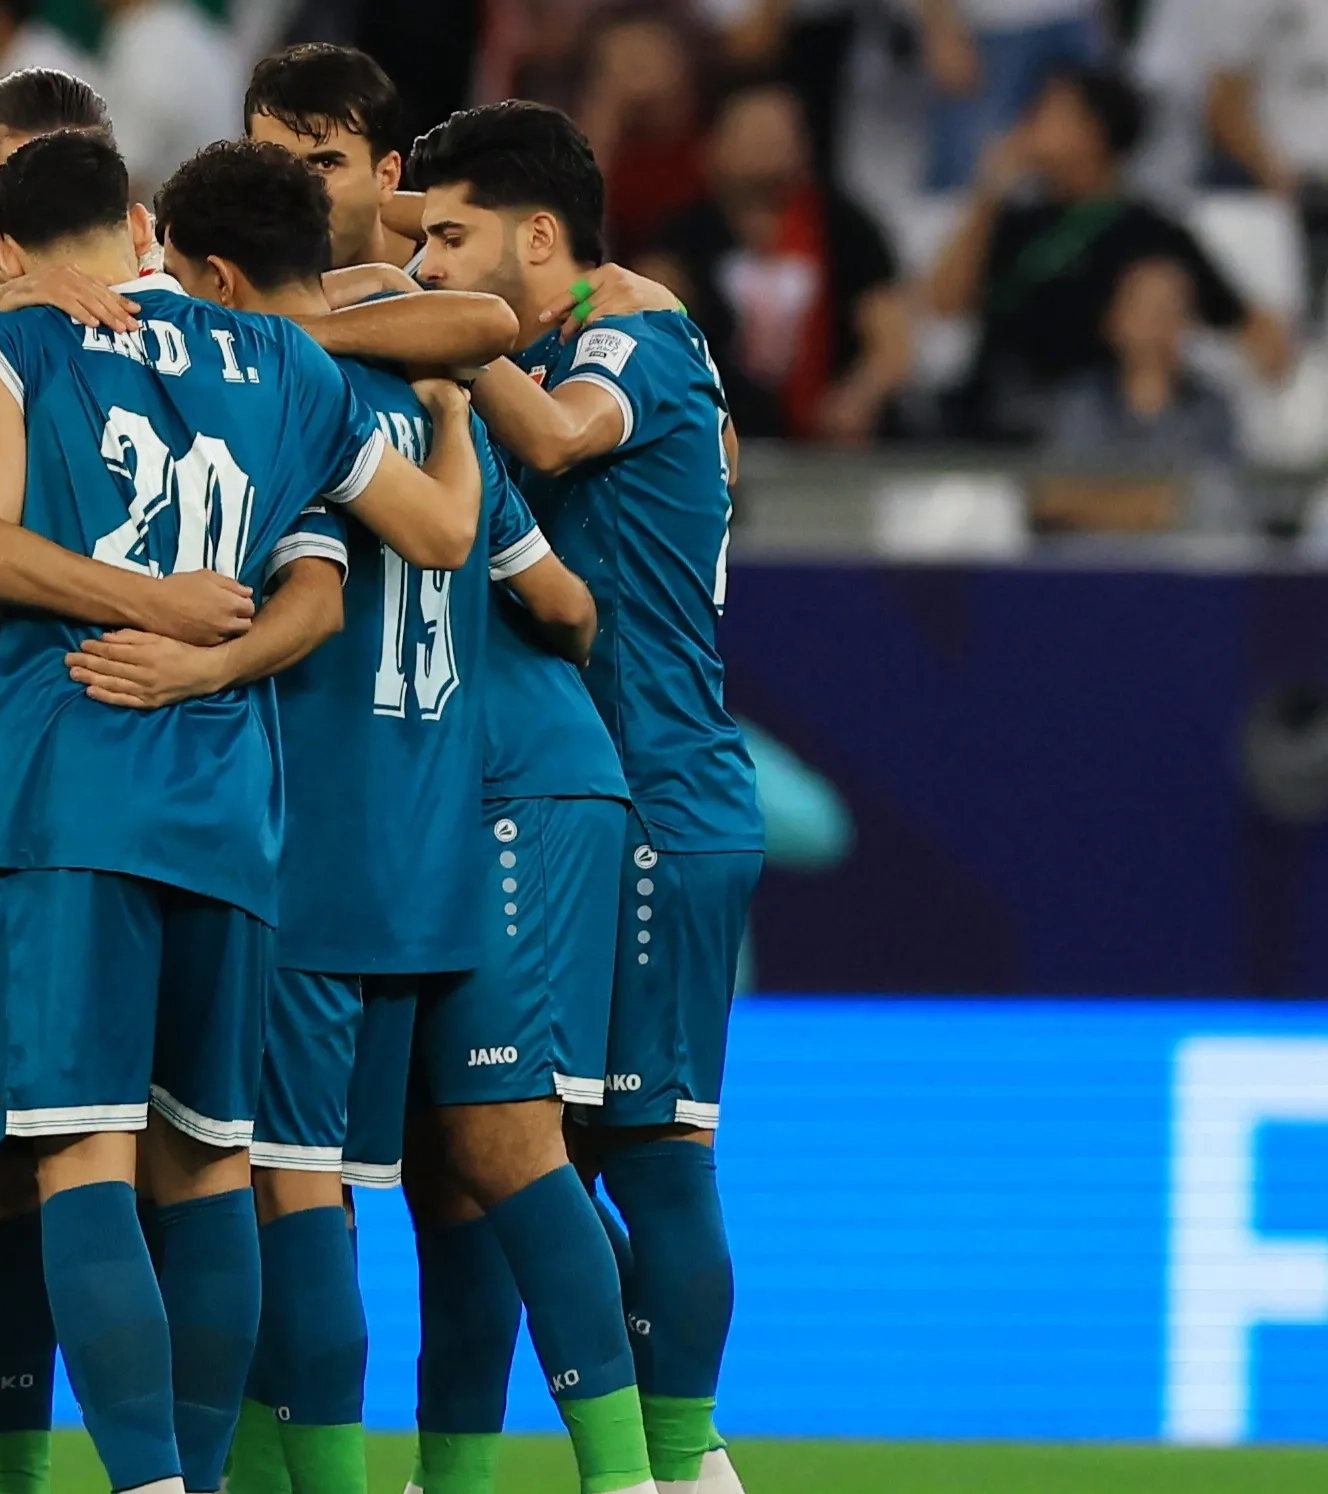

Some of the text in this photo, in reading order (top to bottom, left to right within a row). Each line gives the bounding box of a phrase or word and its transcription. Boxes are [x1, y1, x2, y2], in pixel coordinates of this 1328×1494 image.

[211, 329, 260, 384] I.
[92, 404, 255, 584] 20
[372, 543, 460, 721] 19
[467, 1046, 519, 1067] JAKO
[605, 1073, 642, 1092] AKO
